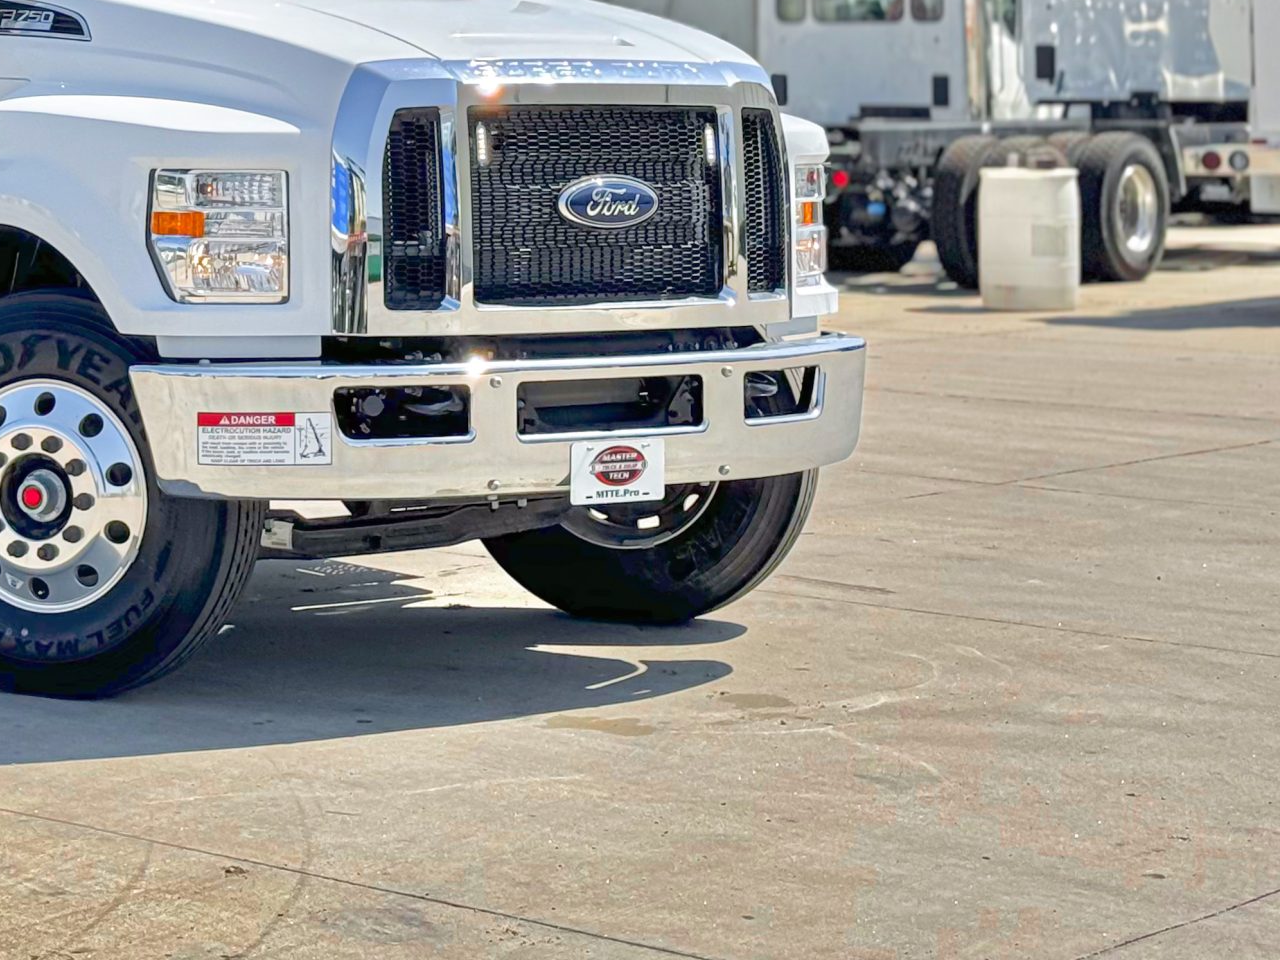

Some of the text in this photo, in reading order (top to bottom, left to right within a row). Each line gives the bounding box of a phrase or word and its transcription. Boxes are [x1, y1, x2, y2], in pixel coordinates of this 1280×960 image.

[586, 187, 640, 217] Ford
[230, 415, 276, 425] DANGER
[602, 452, 638, 461] MASTER
[608, 471, 630, 480] TECH
[595, 488, 640, 499] MTTE.Pro
[86, 587, 155, 648] FUEL
